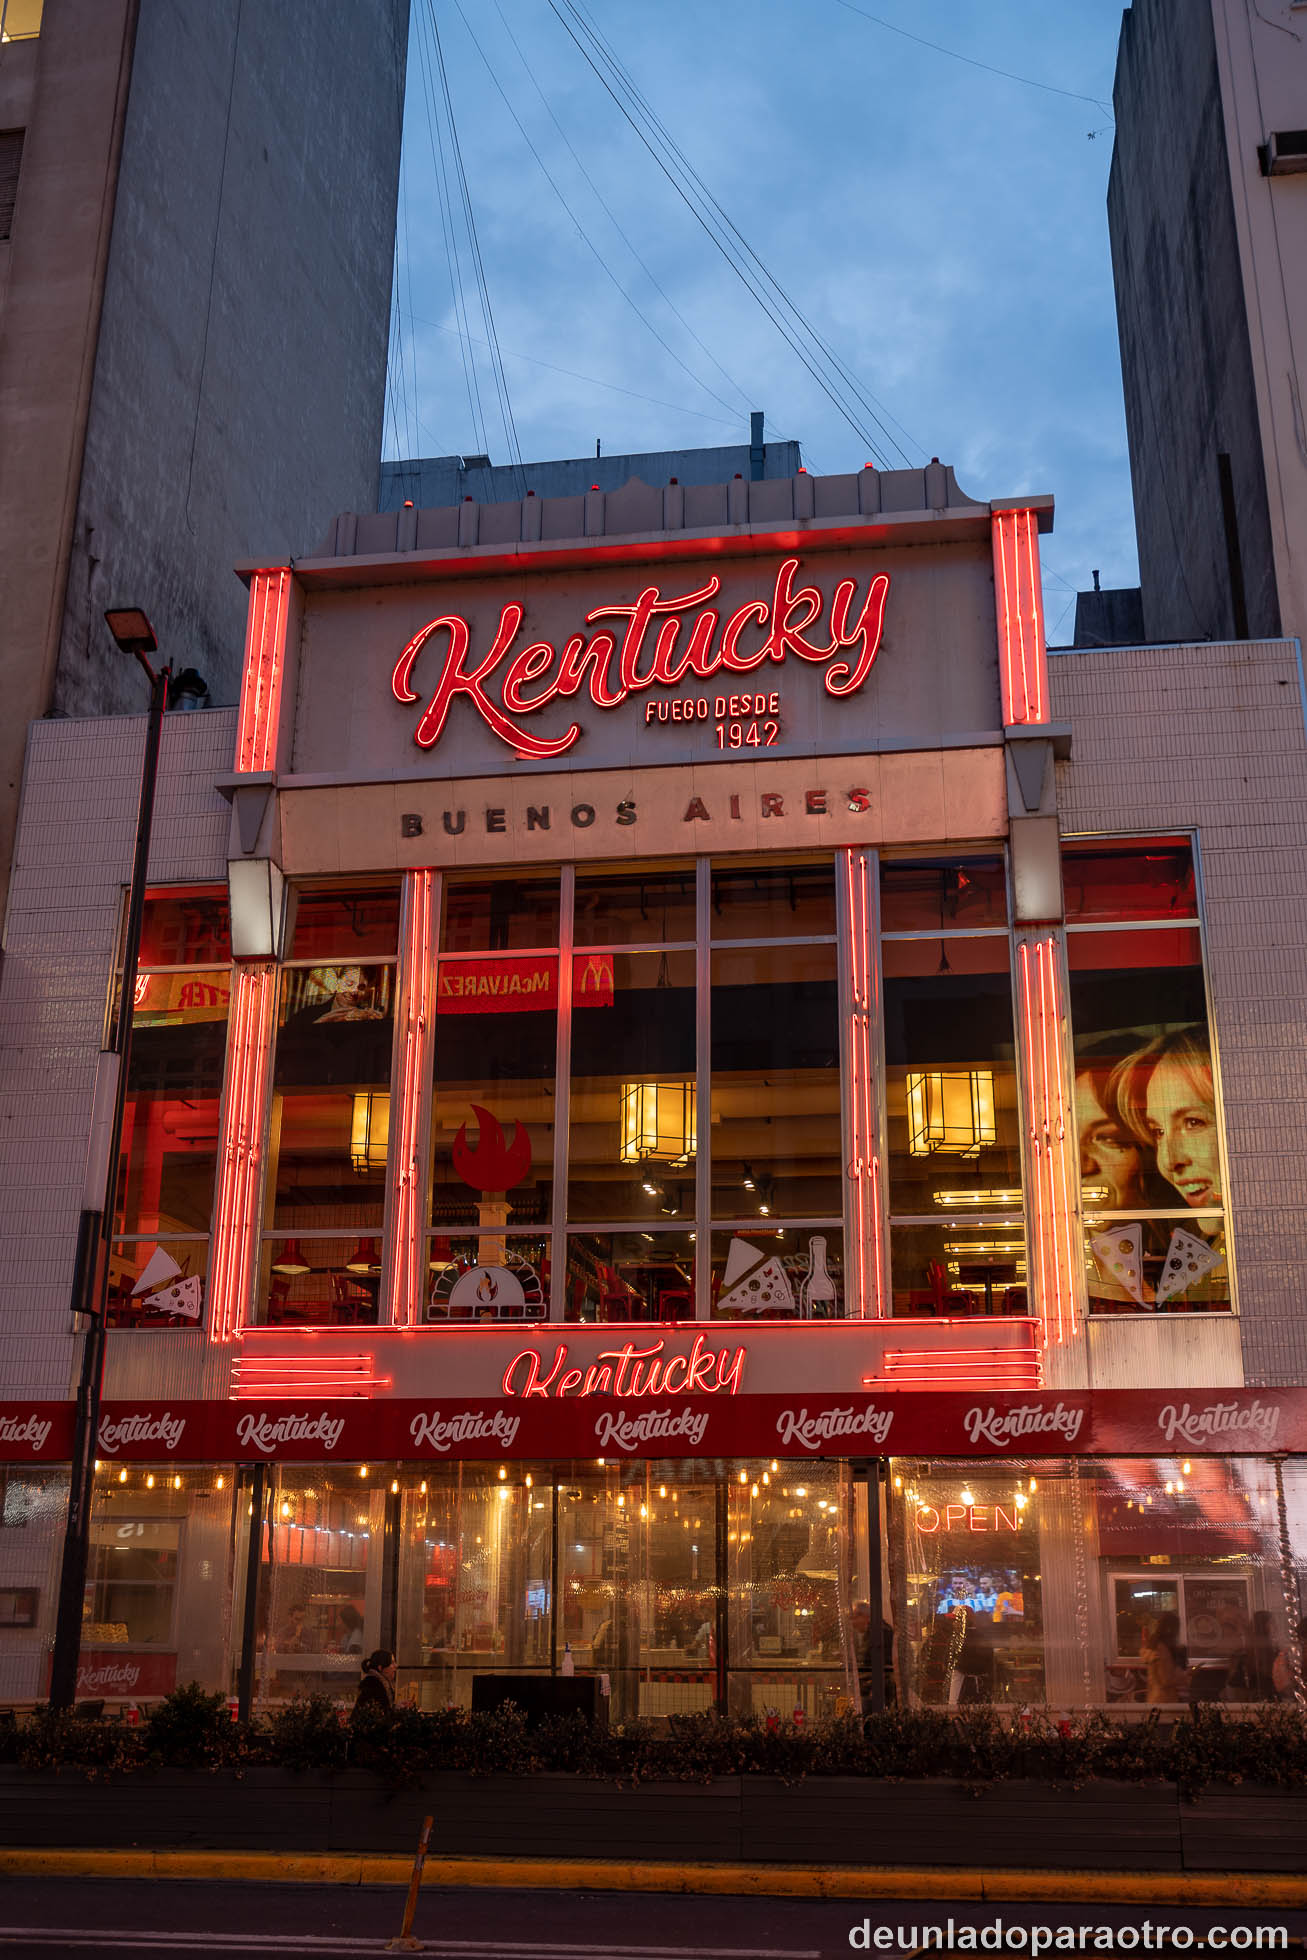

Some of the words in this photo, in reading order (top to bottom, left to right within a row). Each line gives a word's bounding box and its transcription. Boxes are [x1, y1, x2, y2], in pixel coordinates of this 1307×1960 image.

[391, 557, 891, 758] Kentucky
[645, 697, 709, 723] FUEGO
[714, 691, 780, 719] DESDE
[715, 720, 780, 749] 1942
[402, 800, 637, 838] BUENOS
[683, 787, 872, 822] AIRES
[502, 1333, 747, 1398] Kentucky
[236, 1412, 345, 1453] Kentucky
[410, 1410, 520, 1452] Kentucky
[595, 1407, 709, 1451] Kentucky
[776, 1404, 893, 1450] Kentucky
[964, 1402, 1083, 1446] Kentucky
[1158, 1400, 1281, 1445] Kentucky
[915, 1503, 1018, 1533] OPEN
[76, 1662, 141, 1691] Kentucky
